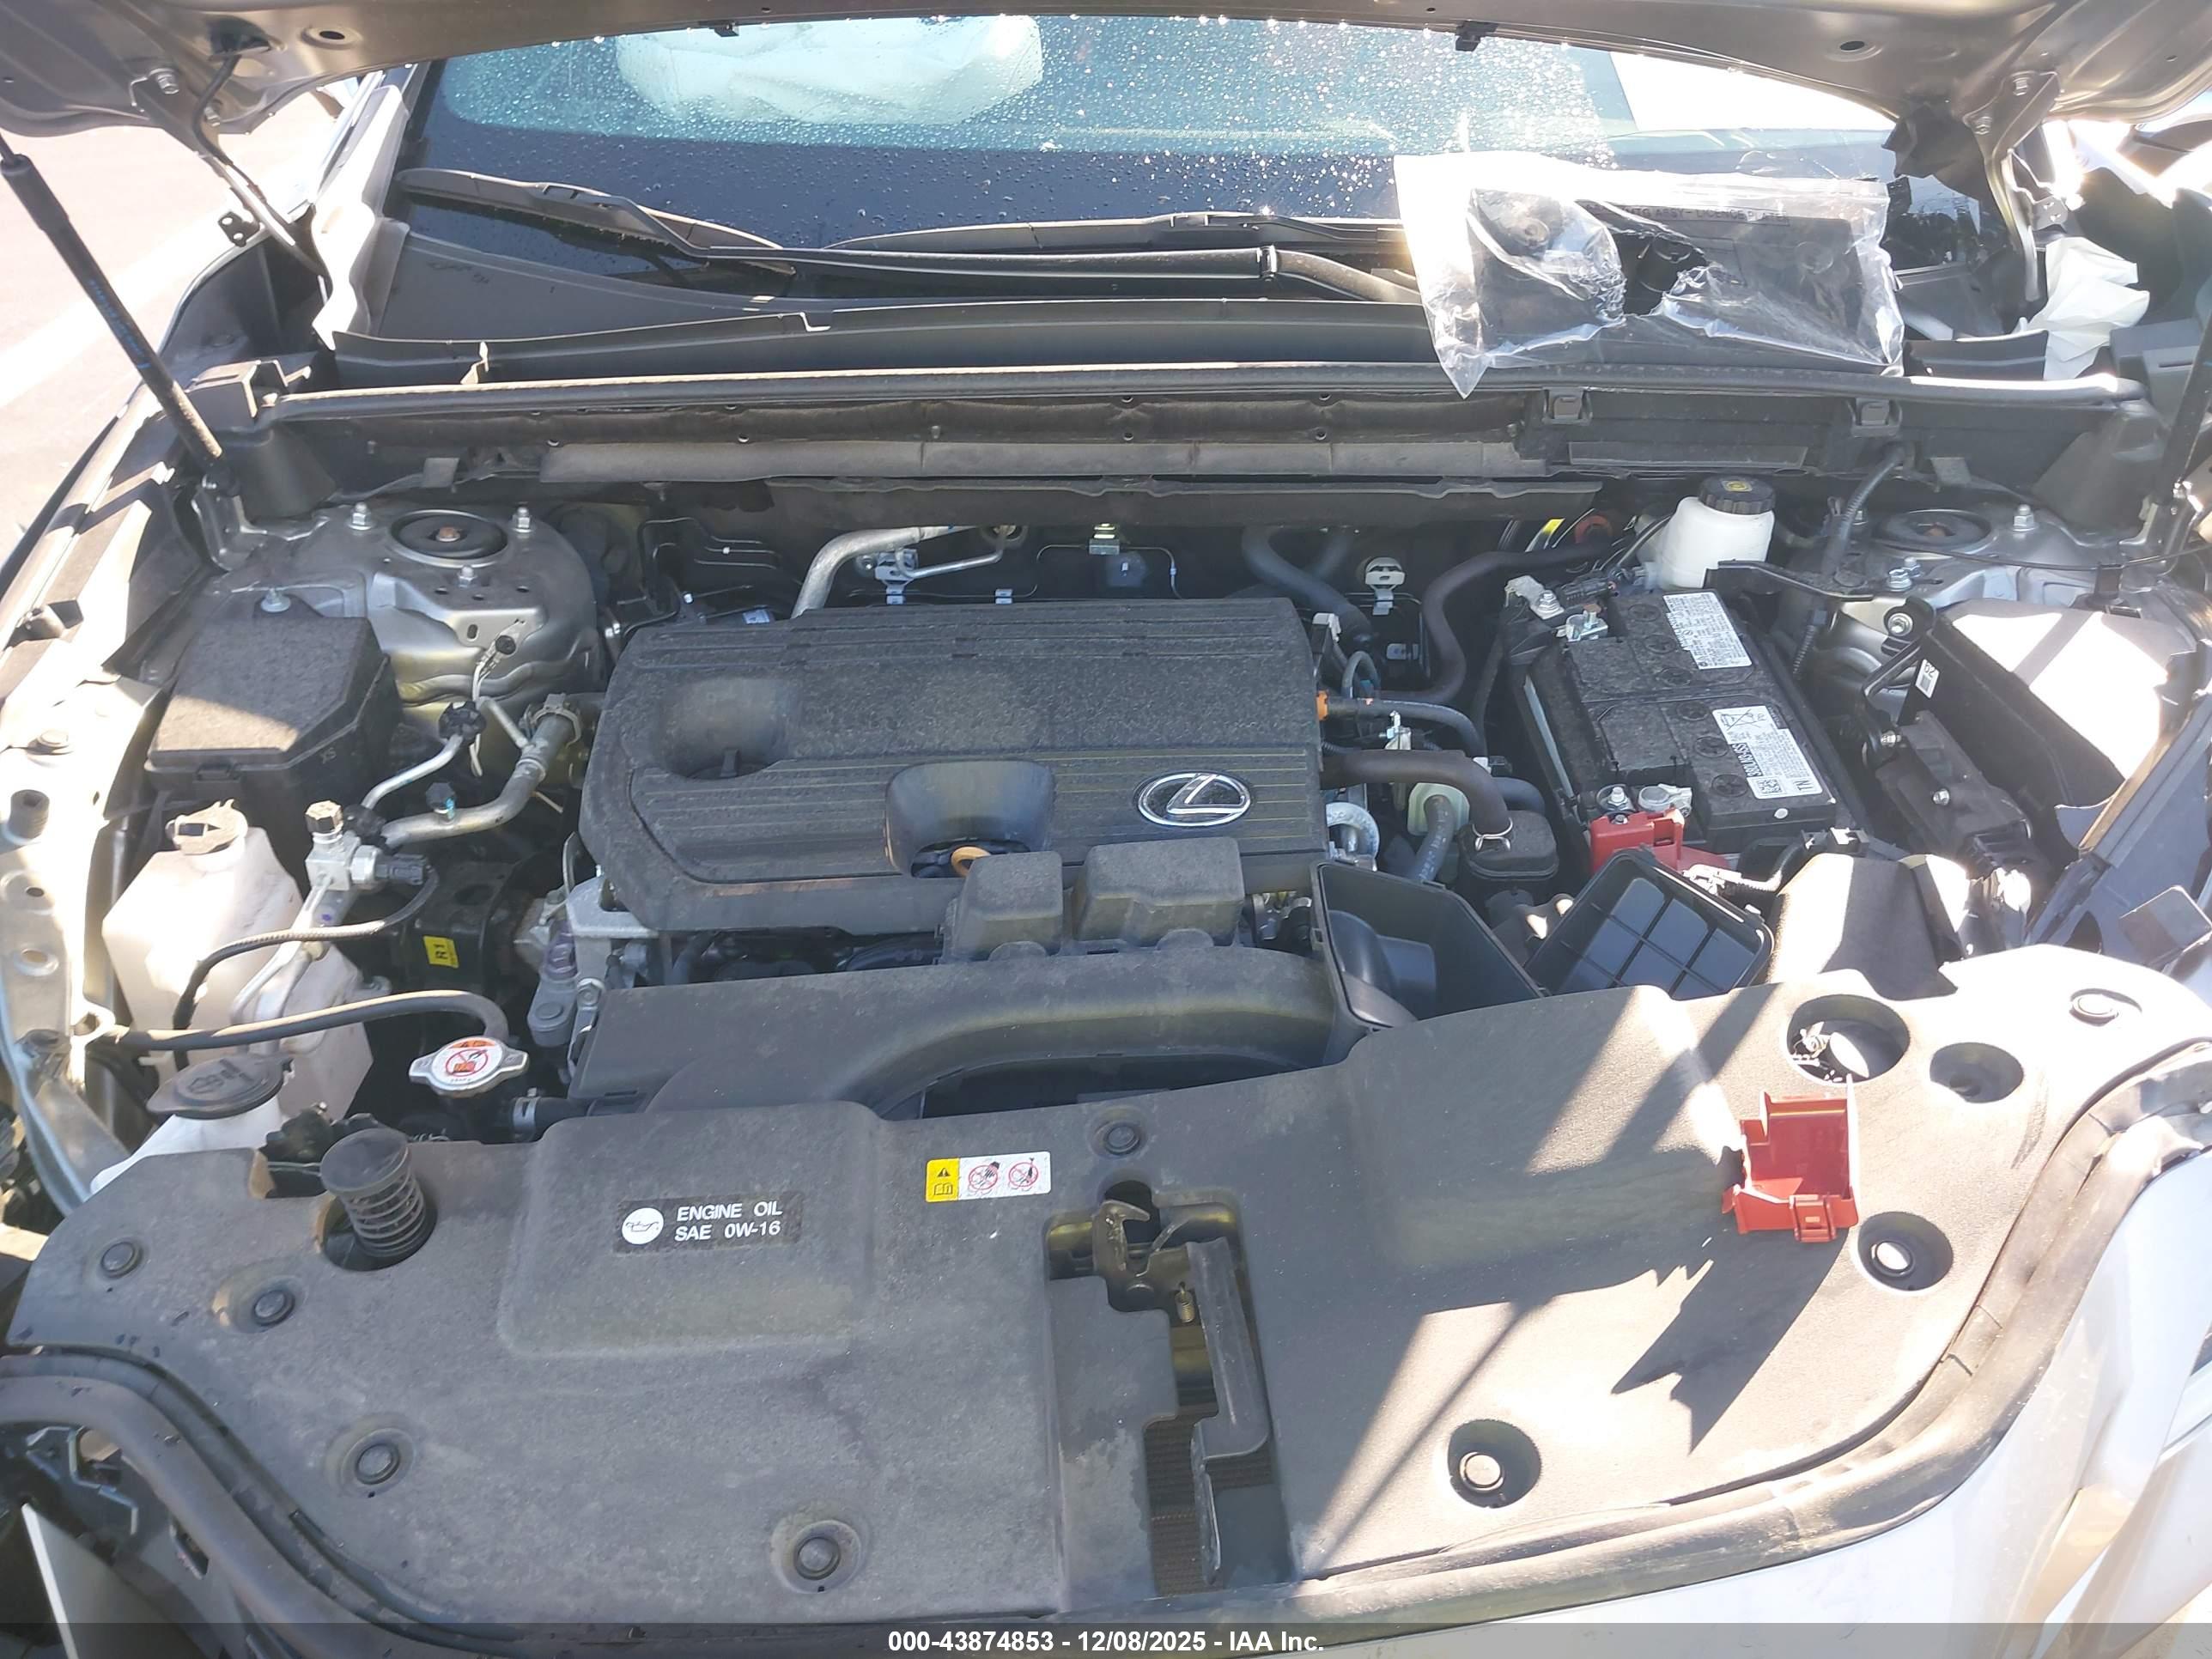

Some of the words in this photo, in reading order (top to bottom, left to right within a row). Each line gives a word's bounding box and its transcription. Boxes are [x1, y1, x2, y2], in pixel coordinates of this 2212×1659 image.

[433, 943, 448, 959] R1
[677, 1203, 742, 1221] ENGINE
[753, 1201, 783, 1217] OIL
[674, 1224, 712, 1241] SAE
[724, 1220, 781, 1238] 0W-16
